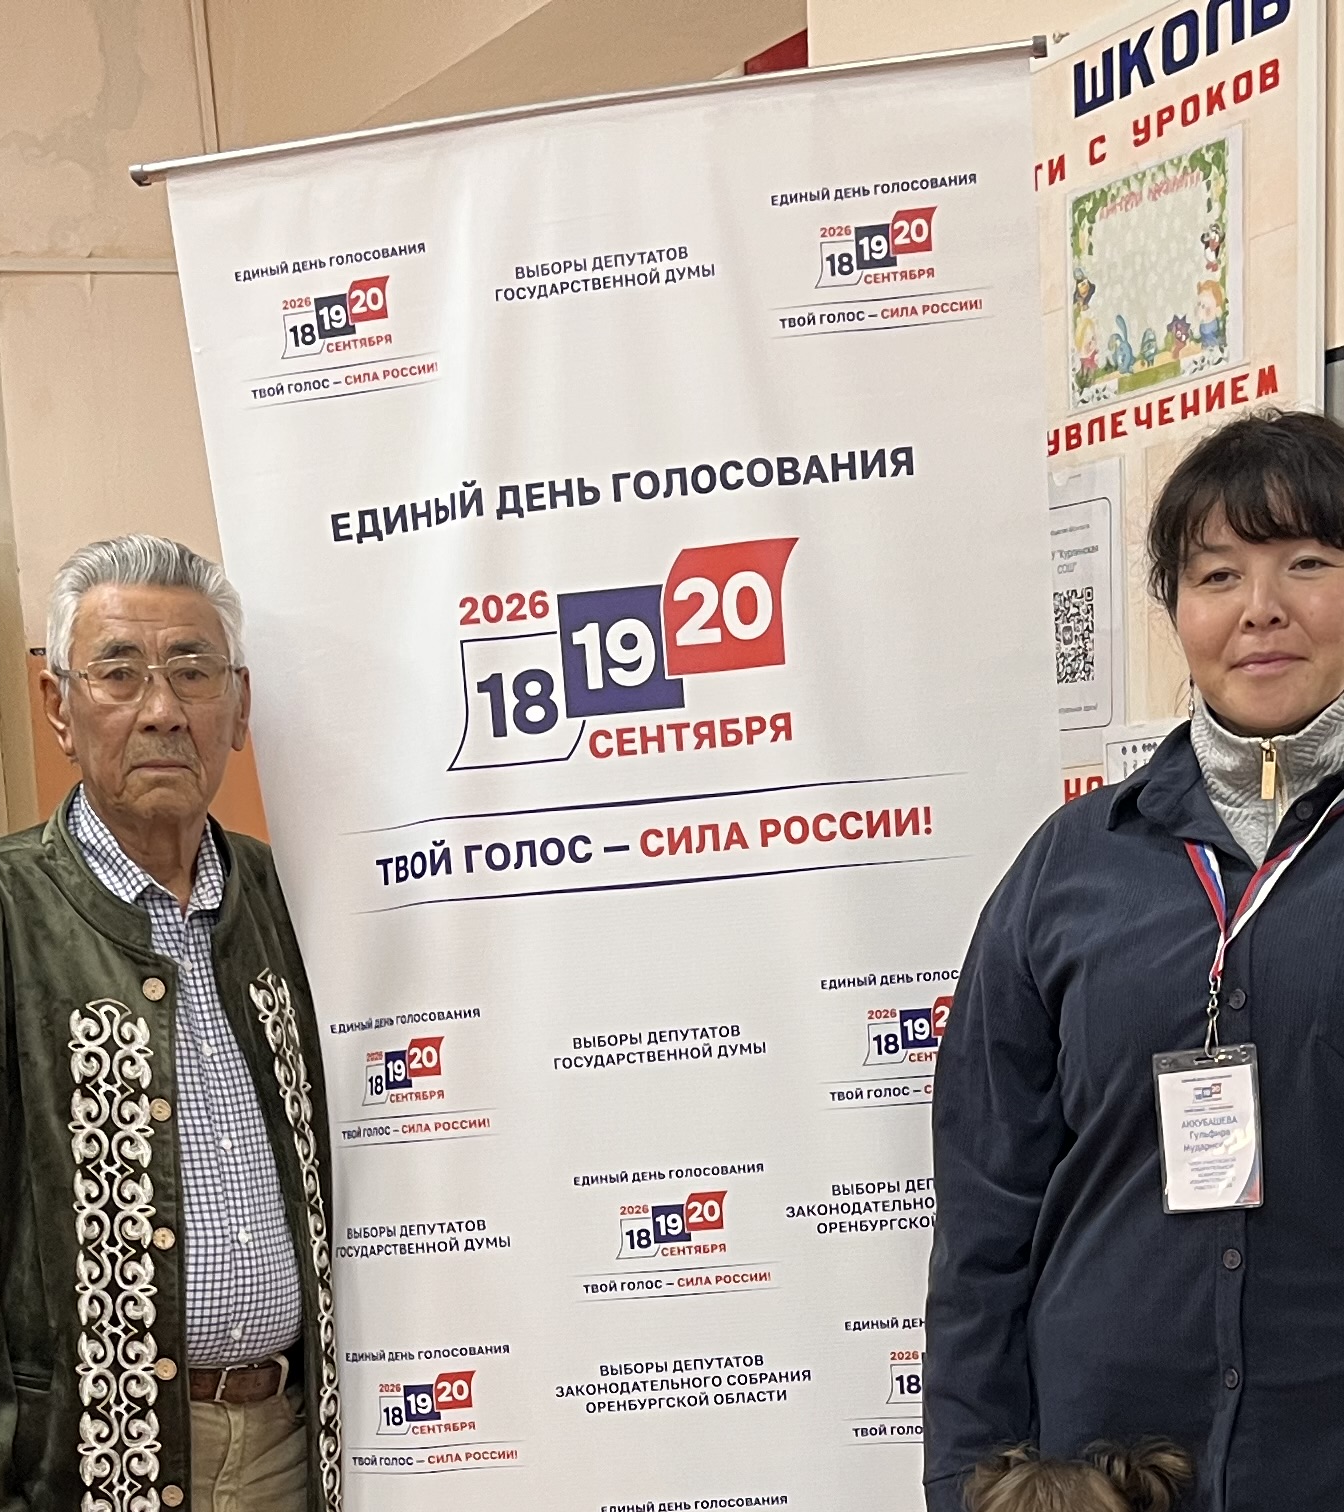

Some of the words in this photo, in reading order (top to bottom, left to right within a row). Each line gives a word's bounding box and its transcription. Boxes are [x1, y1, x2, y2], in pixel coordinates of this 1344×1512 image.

[1088, 134, 1108, 166] С
[1132, 58, 1280, 147] УРОКОВ
[770, 187, 831, 207] ЕДИНЫЙ
[833, 185, 871, 202] ДЕНЬ
[873, 173, 977, 196] ГОЛОСОВАНИЯ
[819, 225, 852, 239] 2026
[234, 260, 289, 283] ЕДИНЫЙ
[291, 258, 327, 274] ДЕНЬ
[329, 242, 426, 267] ГОЛОСОВАНИЯ
[515, 258, 587, 280] ВЫБОРЫ
[591, 246, 689, 272] ДЕПУТАТОВ
[825, 251, 854, 276] 18
[858, 235, 889, 261] 19
[892, 220, 927, 247] 20
[495, 267, 661, 302] ГОСУДАРСТВЕННОЙ
[664, 263, 716, 285] ДУМЫ
[863, 267, 935, 285] СЕНТЯБРЯ
[282, 297, 311, 311] 2026
[289, 324, 316, 347] 18
[319, 305, 346, 330] 19
[350, 288, 384, 314] 20
[779, 312, 816, 329] ТВОЙ
[819, 310, 866, 325] ГОЛОС
[880, 305, 919, 320] СИЛА
[921, 298, 983, 316] РОССИИ!
[326, 333, 393, 353] СЕНТЯБРЯ
[250, 382, 285, 400] ТВОЙ
[287, 378, 330, 394] ГОЛОС
[344, 371, 380, 386] СИЛА
[382, 362, 438, 380] РОССИИ!
[1047, 364, 1279, 457] УВЛЕЧЕНИЕМ
[330, 487, 484, 545] ЕДИНЫЙ
[495, 477, 601, 521] ДЕНЬ
[611, 446, 914, 503] ГОЛОСОВАНИЯ
[459, 590, 549, 625] 2026
[476, 667, 559, 738] 18
[571, 617, 656, 691] 19
[674, 570, 773, 647] 20
[588, 711, 793, 759] СЕНТЯБРЯ
[375, 842, 453, 886] ТВОЙ
[463, 834, 593, 874] ГОЛОС
[639, 821, 750, 858] СИЛА
[759, 806, 931, 848] РОССИИ!
[572, 1032, 643, 1050] ВЫБОРЫ
[646, 1024, 741, 1046] ДЕПУТАТОВ
[553, 1042, 713, 1070] ГОСУДАРСТВЕННОЙ
[717, 1041, 766, 1060] ДУМЫ
[573, 1170, 629, 1187] ЕДИНЫЙ
[631, 1170, 666, 1184] ДЕНЬ
[668, 1162, 765, 1179] ГОЛОСОВАНИЯ
[831, 1180, 901, 1197] ВЫБОРЫ
[346, 1225, 397, 1240] ВЫБОРЫ
[399, 1219, 487, 1239] ДЕПУТАТОВ
[625, 1229, 651, 1250] 18
[655, 1213, 683, 1235] 19
[687, 1200, 720, 1222] 20
[334, 1236, 460, 1259] ГОСУДАРСТВЕННОЙ
[463, 1235, 511, 1252] ДУМЫ
[659, 1241, 727, 1257] СЕНТЯБРЯ
[582, 1280, 618, 1294] ТВОЙ
[620, 1279, 663, 1292] ГОЛОС
[677, 1275, 713, 1288] СИЛА
[715, 1271, 771, 1285] РОССИИ!
[599, 1361, 668, 1377] ВЫБОРЫ
[672, 1354, 764, 1374] ДЕПУТАТОВ
[555, 1375, 723, 1398] ЗАКОНОДАТЕЛЬНОГО
[726, 1369, 812, 1386] СОБРАНИЯ
[585, 1391, 710, 1414] ОРЕНБУРГСКОЙ
[713, 1389, 787, 1406] ОБЛАСТИ
[694, 1495, 788, 1510] ГОЛОСОВАНИЯ
